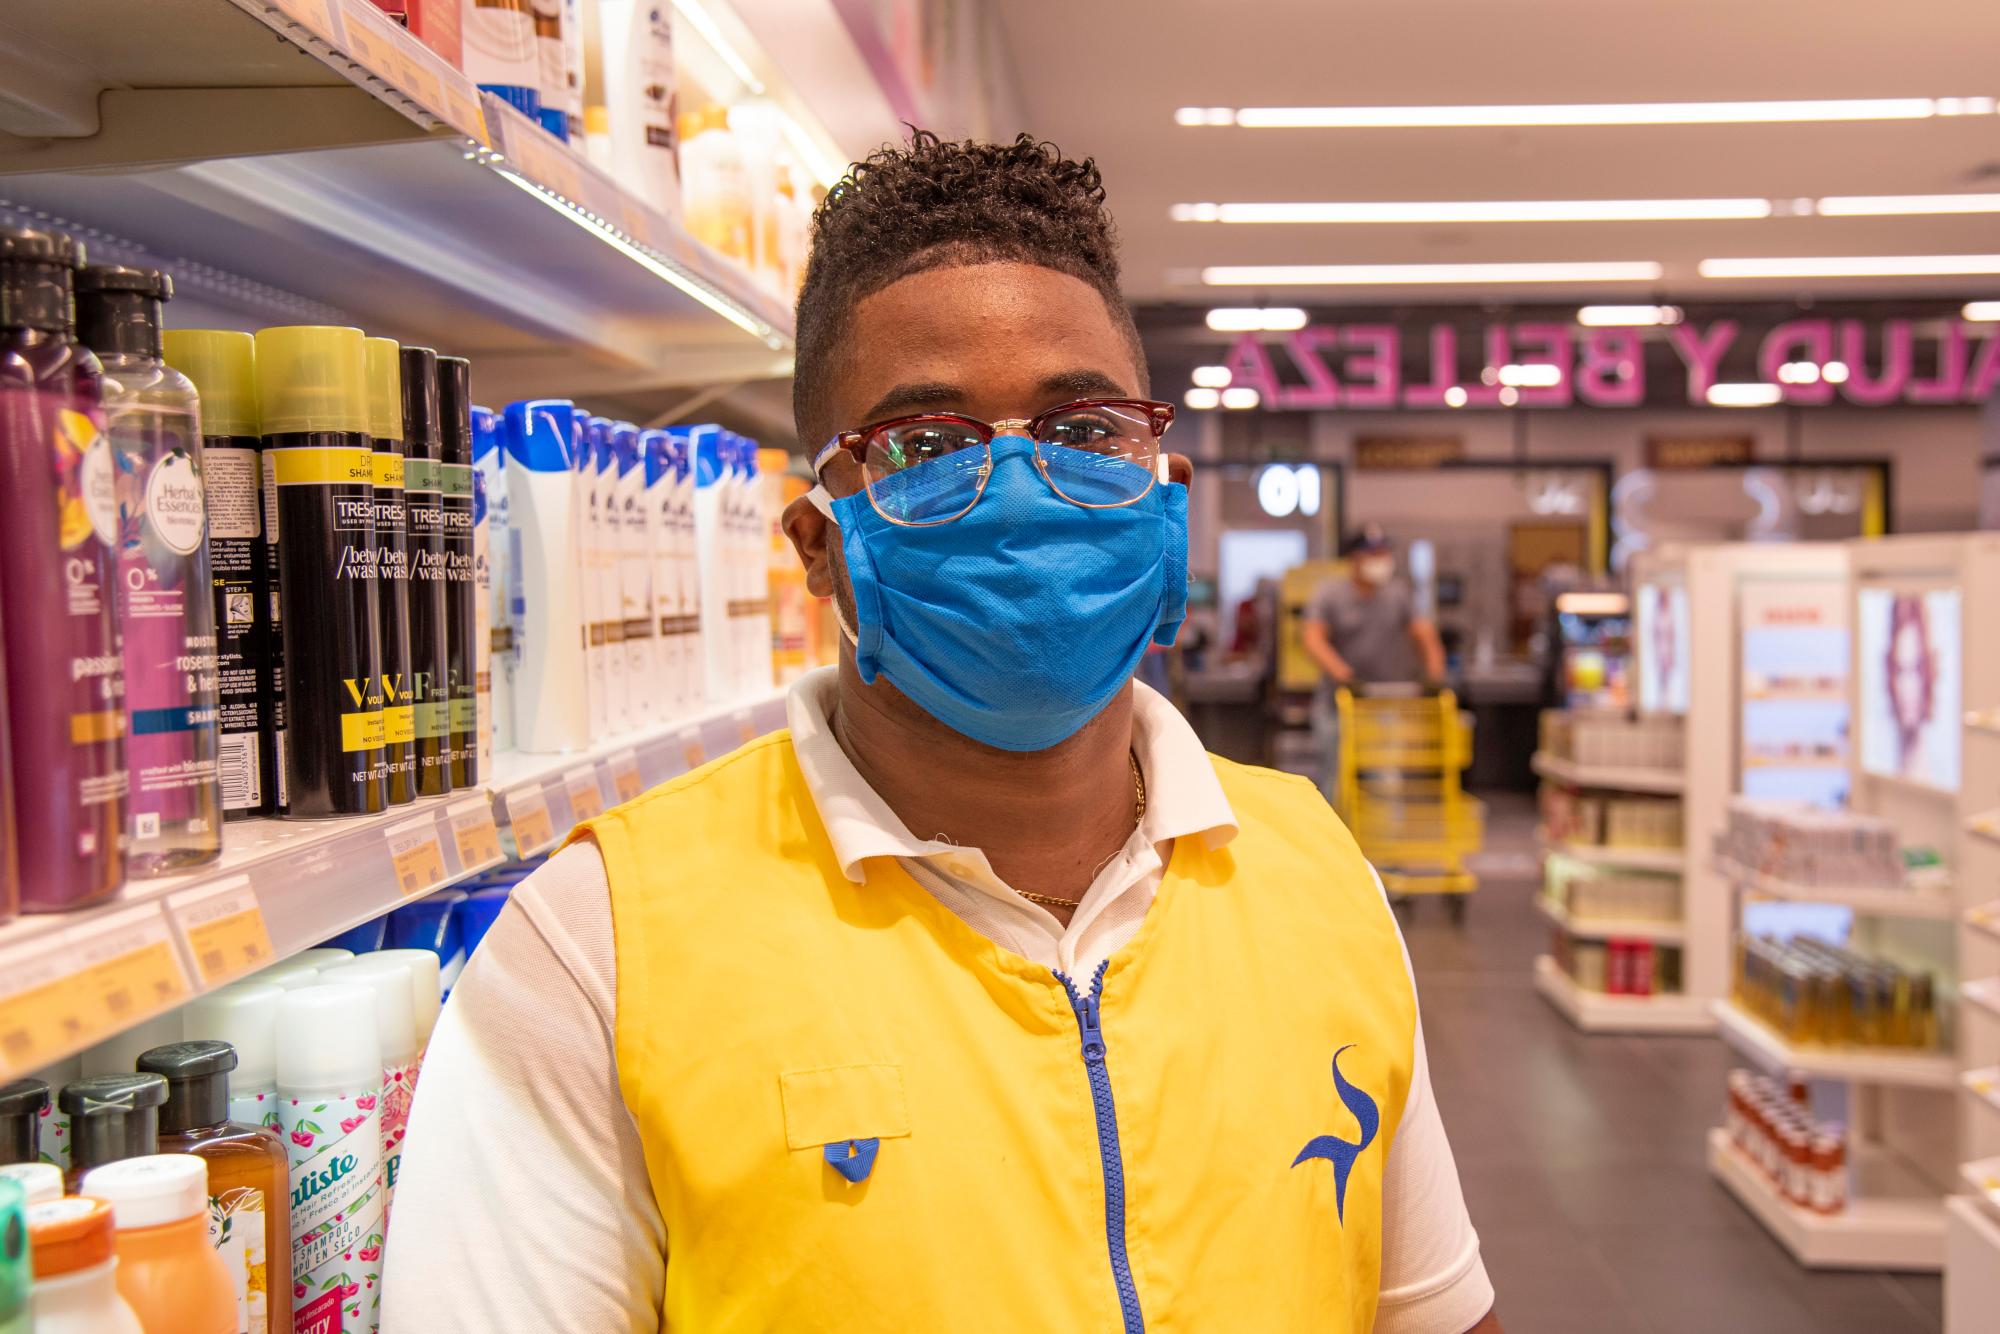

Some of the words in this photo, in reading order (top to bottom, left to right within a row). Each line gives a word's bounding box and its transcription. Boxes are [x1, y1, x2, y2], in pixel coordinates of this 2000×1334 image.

[343, 677, 371, 708] V
[422, 756, 435, 767] NET
[352, 771, 367, 782] NET
[368, 769, 378, 781] WT
[300, 1201, 317, 1214] Hair
[309, 1197, 339, 1219] Fresco
[301, 1221, 349, 1260] SHAMPOO
[316, 1249, 329, 1264] EN
[334, 1226, 361, 1252] SECO
